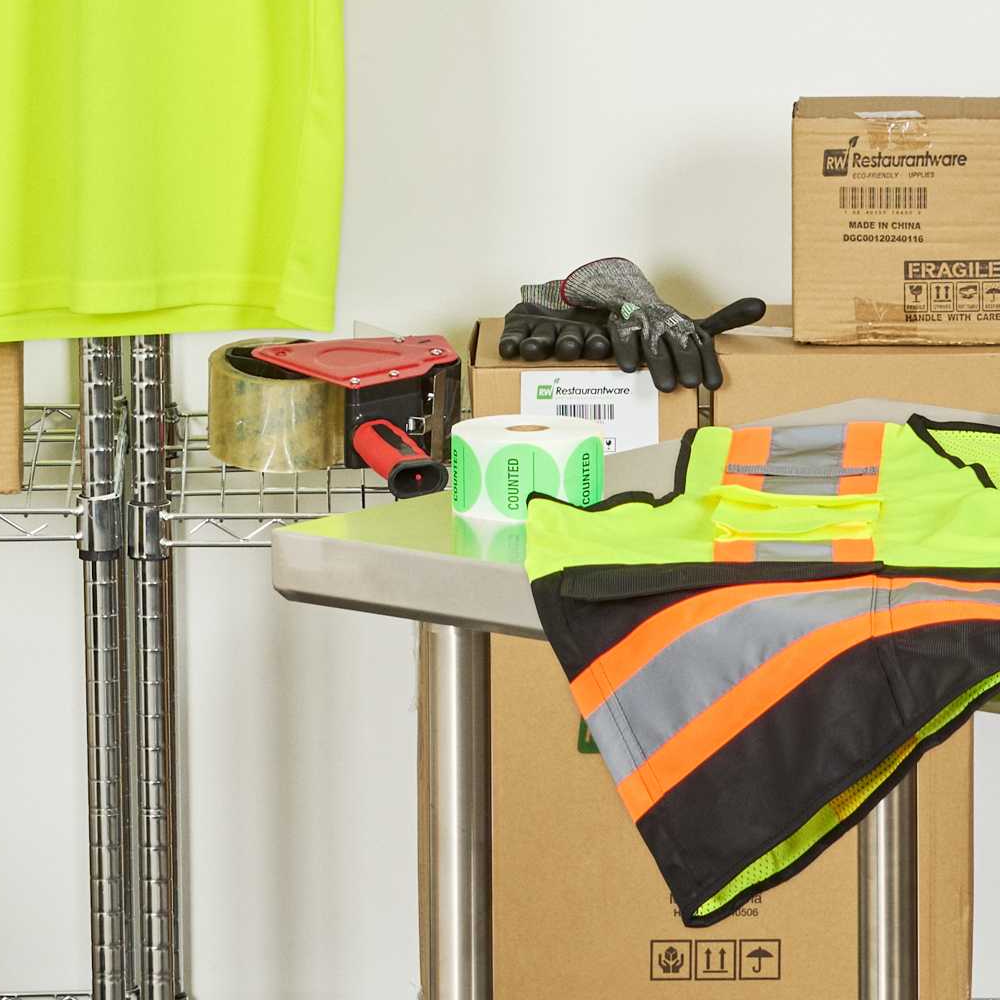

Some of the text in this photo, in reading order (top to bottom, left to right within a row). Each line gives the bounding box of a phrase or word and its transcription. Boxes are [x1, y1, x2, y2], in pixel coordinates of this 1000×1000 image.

[827, 155, 848, 171] RW
[852, 150, 968, 168] Restaurantware
[849, 222, 921, 230] MADE IN CHINA
[908, 262, 1000, 279] FRAGILE
[905, 313, 1000, 322] HANDLE WITH CARE
[555, 386, 630, 396] Restaurantware
[507, 457, 519, 511] COUNTED
[582, 452, 591, 505] COUNTED
